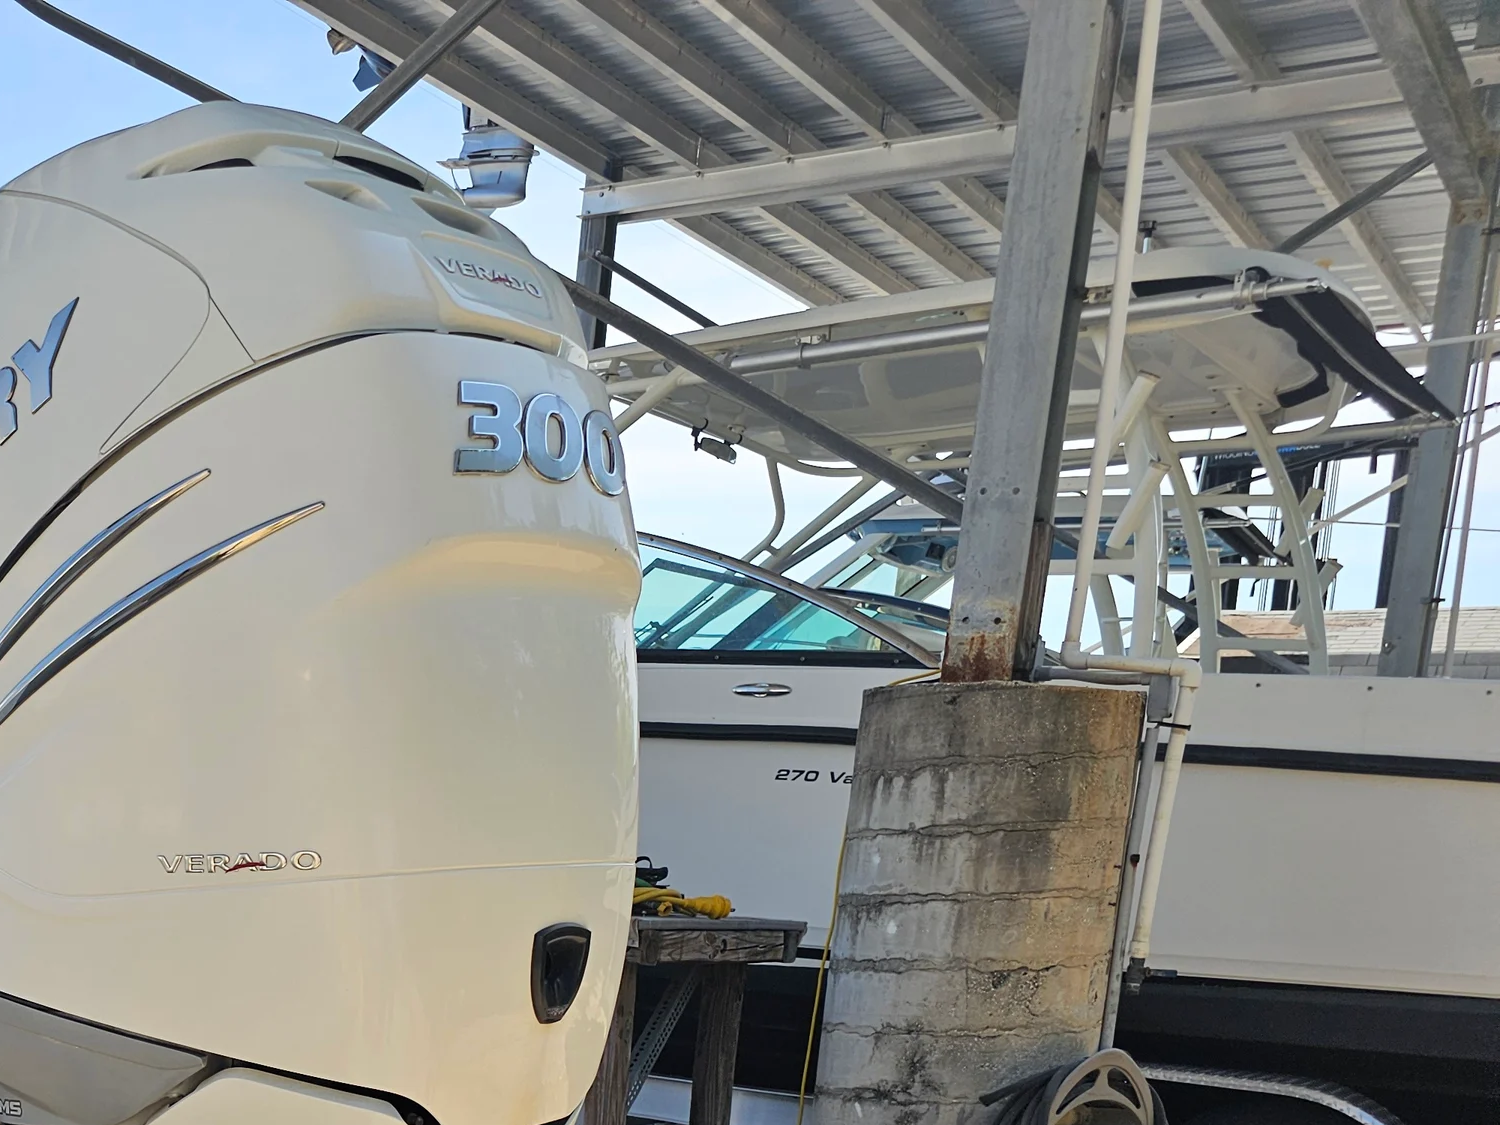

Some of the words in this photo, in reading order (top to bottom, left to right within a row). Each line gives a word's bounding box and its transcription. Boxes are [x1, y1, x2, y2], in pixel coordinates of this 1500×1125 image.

[435, 255, 543, 298] VERADO
[453, 380, 626, 497] 300
[775, 769, 819, 782] 270
[157, 849, 322, 873] VERADO
